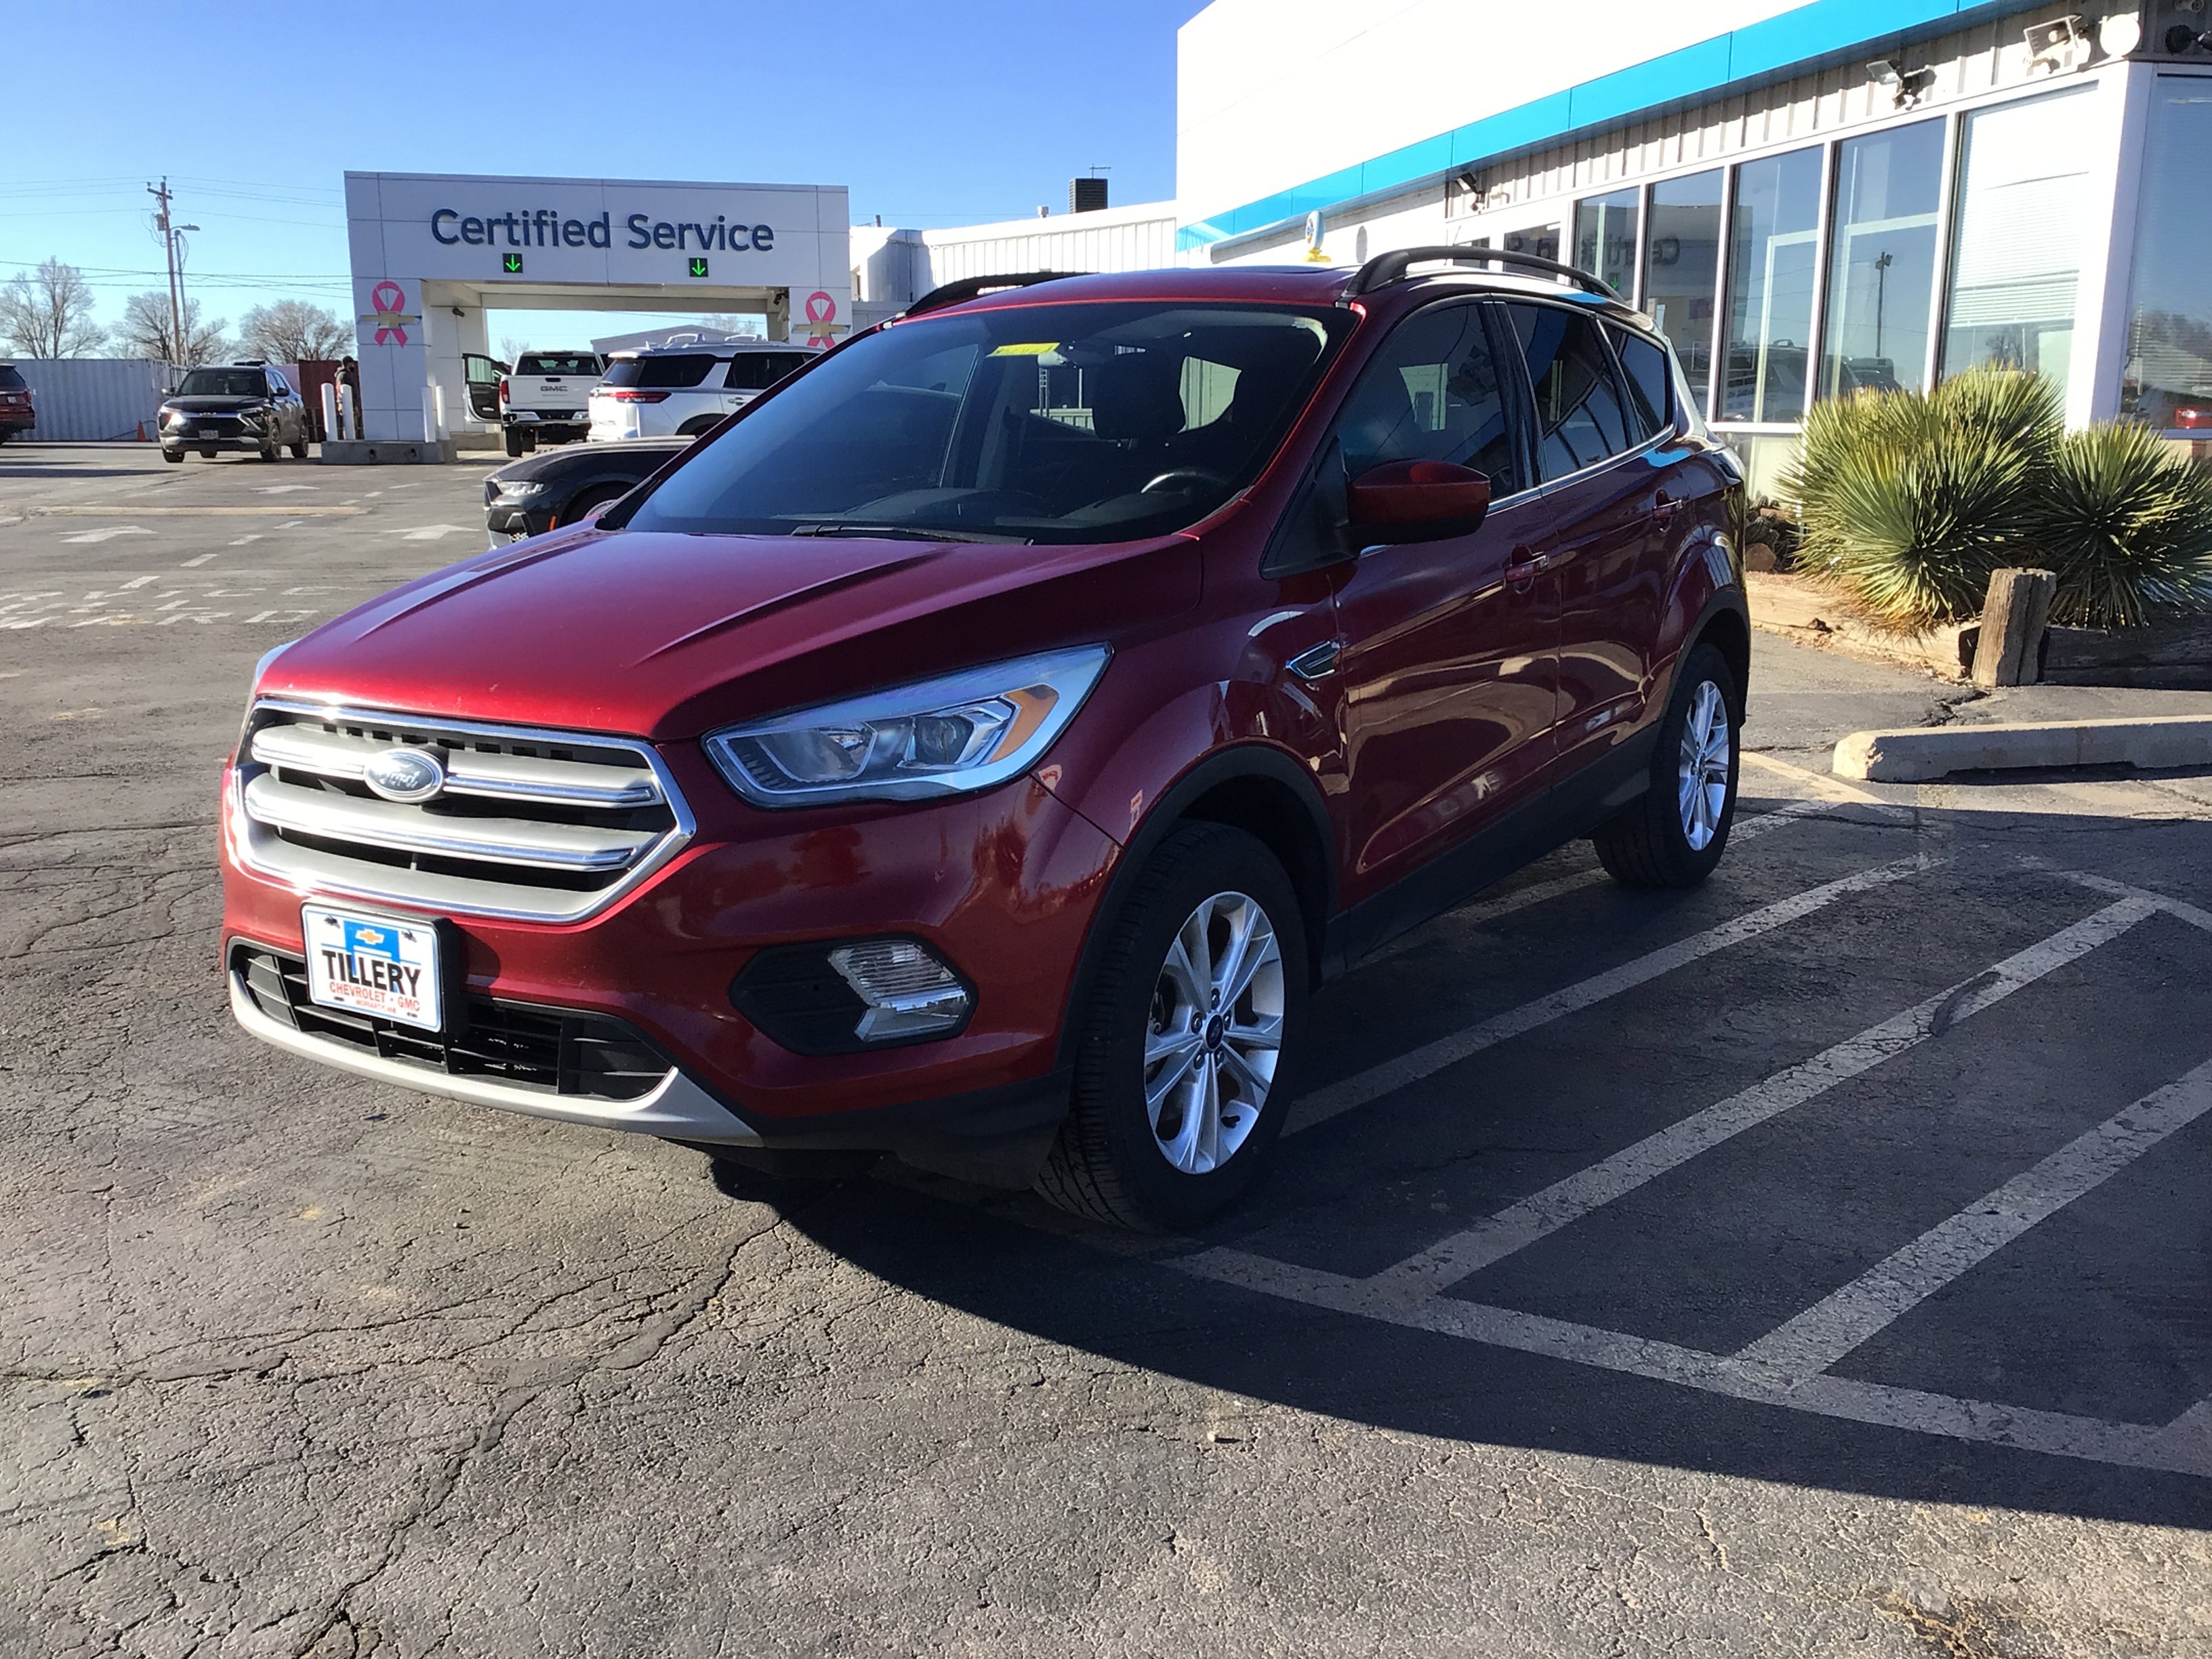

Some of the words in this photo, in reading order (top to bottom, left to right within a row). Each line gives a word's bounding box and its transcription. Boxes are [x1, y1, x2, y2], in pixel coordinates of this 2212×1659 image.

[431, 208, 611, 248] Certified
[628, 213, 774, 251] Service
[321, 949, 422, 998] TILLERY
[329, 981, 386, 1003] CHEVROLET
[398, 995, 420, 1012] GMC
